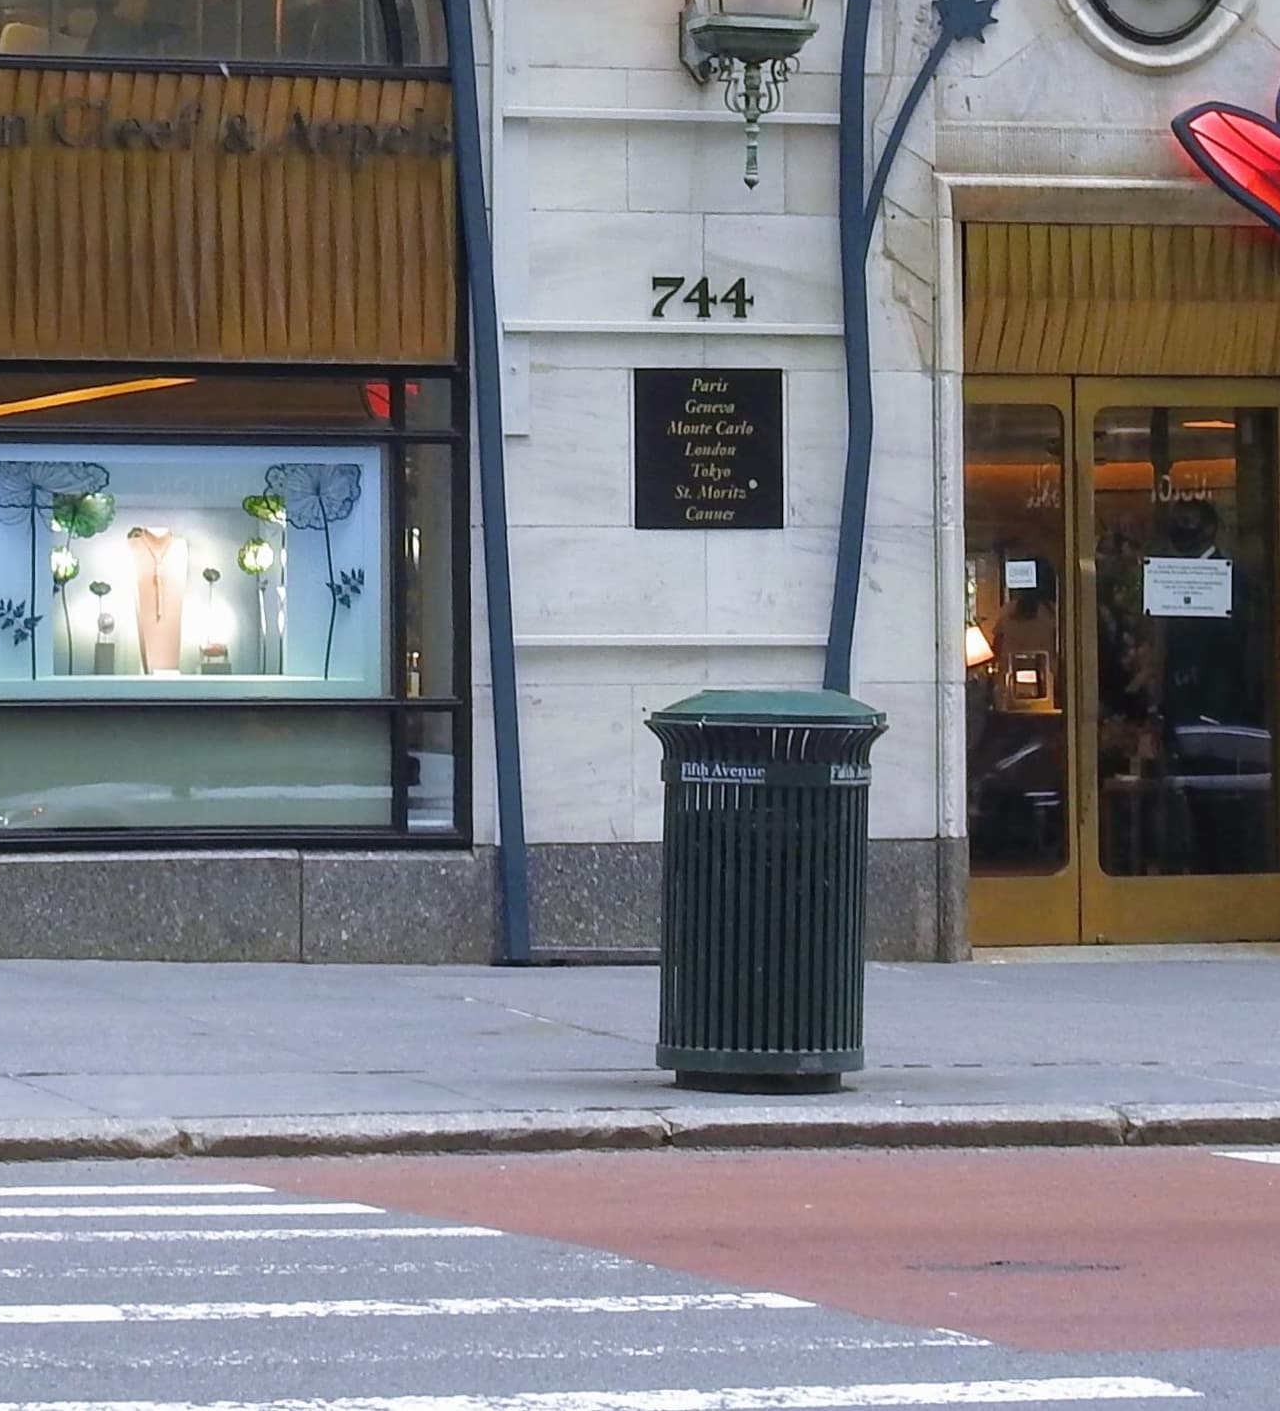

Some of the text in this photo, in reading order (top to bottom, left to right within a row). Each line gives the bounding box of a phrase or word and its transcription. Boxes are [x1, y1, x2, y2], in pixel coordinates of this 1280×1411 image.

[651, 276, 754, 318] 744
[691, 377, 729, 392] Paris
[684, 399, 735, 414] Geneva
[667, 420, 754, 435] Monte Carlo
[684, 441, 736, 456] London
[691, 462, 731, 481] Tokyo
[675, 484, 747, 499] St. Moritz
[685, 506, 735, 521] Cannes
[681, 761, 766, 778] Fifth Avenue
